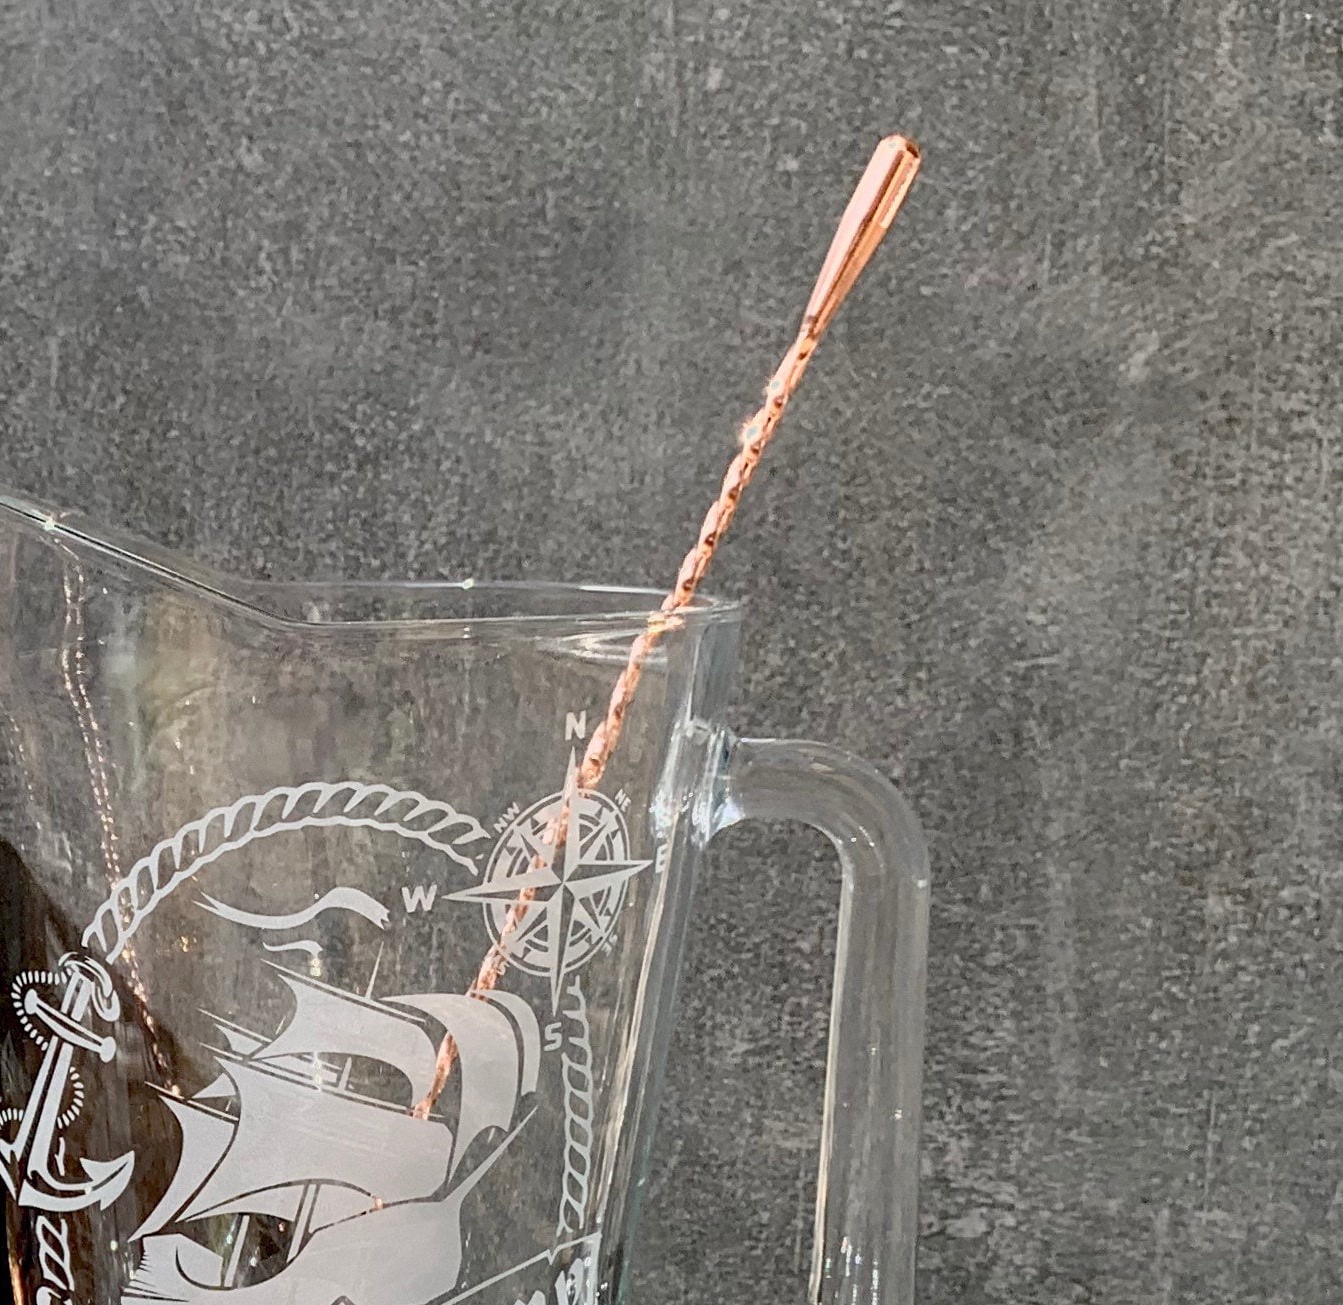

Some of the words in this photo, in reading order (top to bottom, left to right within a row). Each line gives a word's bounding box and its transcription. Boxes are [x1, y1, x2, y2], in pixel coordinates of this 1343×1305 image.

[564, 711, 587, 740] N
[400, 884, 437, 912] W
[543, 1023, 562, 1052] S
